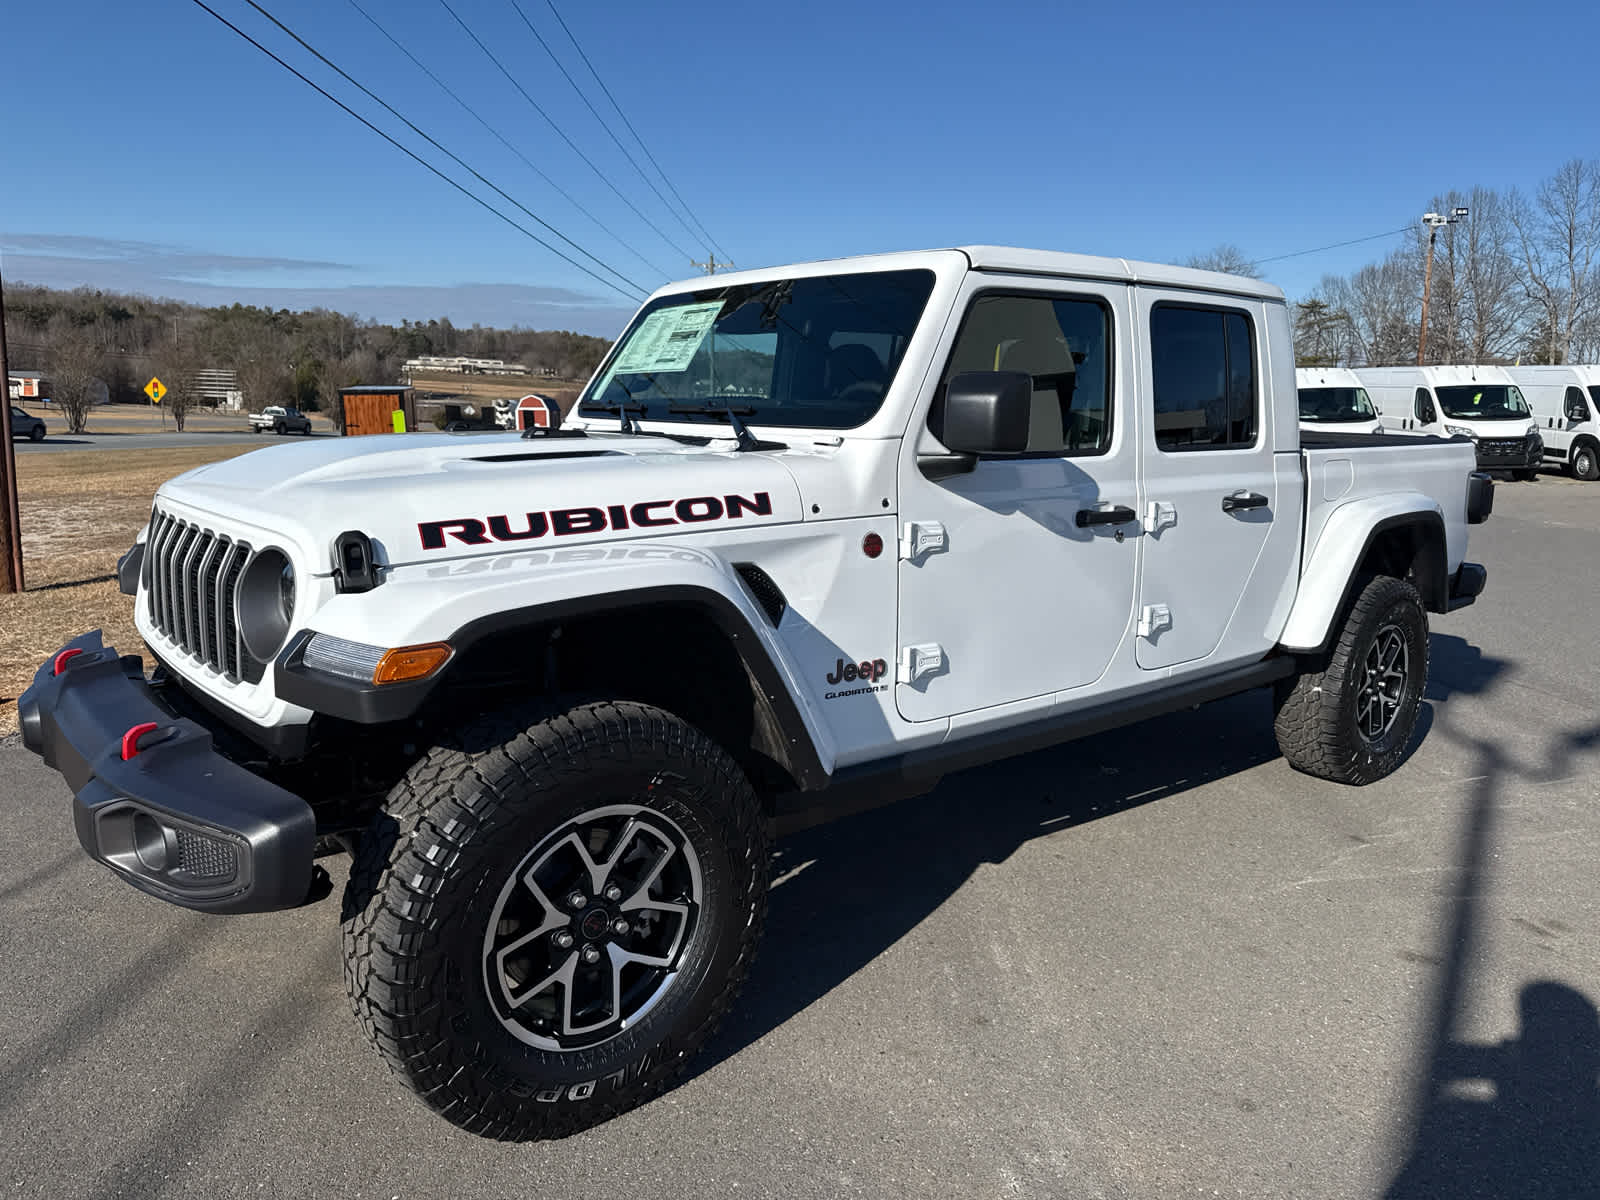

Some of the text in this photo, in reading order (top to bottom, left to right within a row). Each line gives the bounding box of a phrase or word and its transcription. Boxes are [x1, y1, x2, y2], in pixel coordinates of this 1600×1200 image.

[418, 491, 773, 550] RUBICON
[826, 658, 887, 685] Jeep
[824, 686, 879, 700] GLADIATOR
